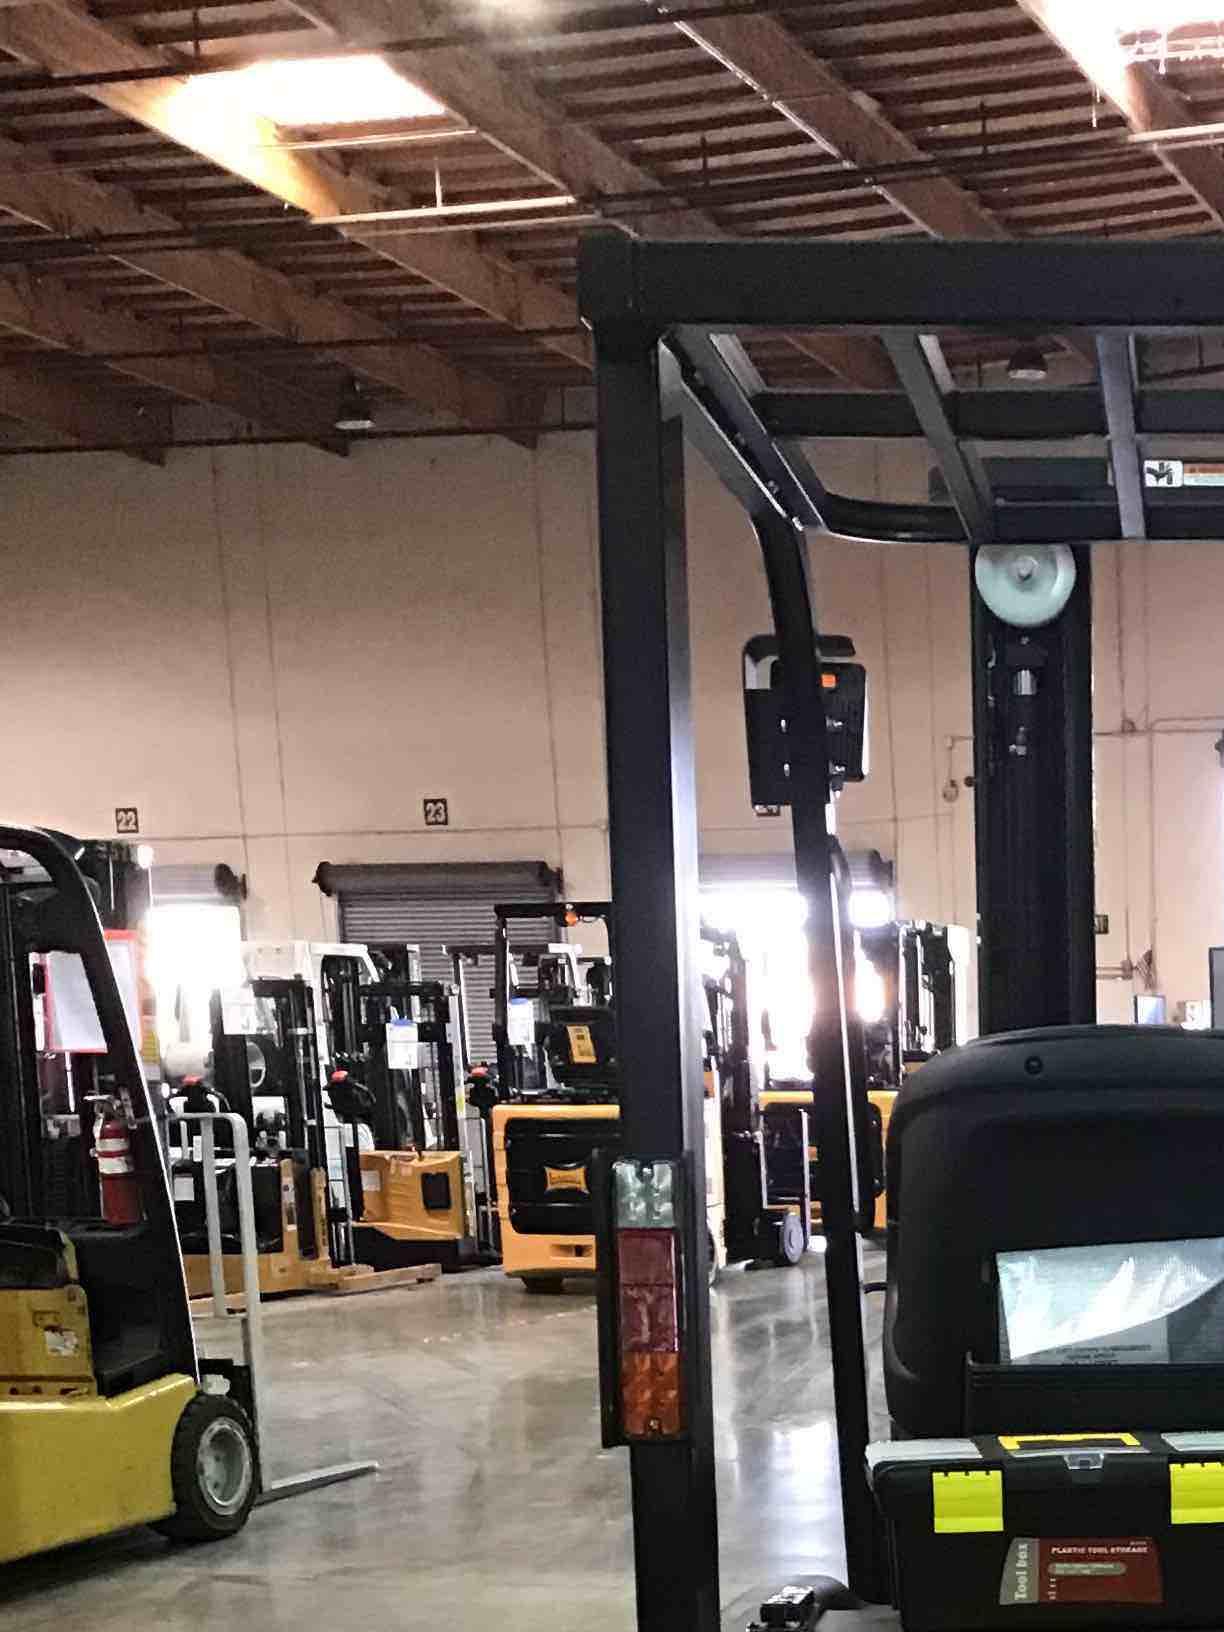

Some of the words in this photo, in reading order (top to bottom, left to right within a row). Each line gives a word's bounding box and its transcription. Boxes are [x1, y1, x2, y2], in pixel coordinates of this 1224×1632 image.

[117, 810, 138, 831] 22
[426, 801, 446, 822] 23
[1016, 1543, 1028, 1568] box
[1015, 1569, 1028, 1600] Tool
